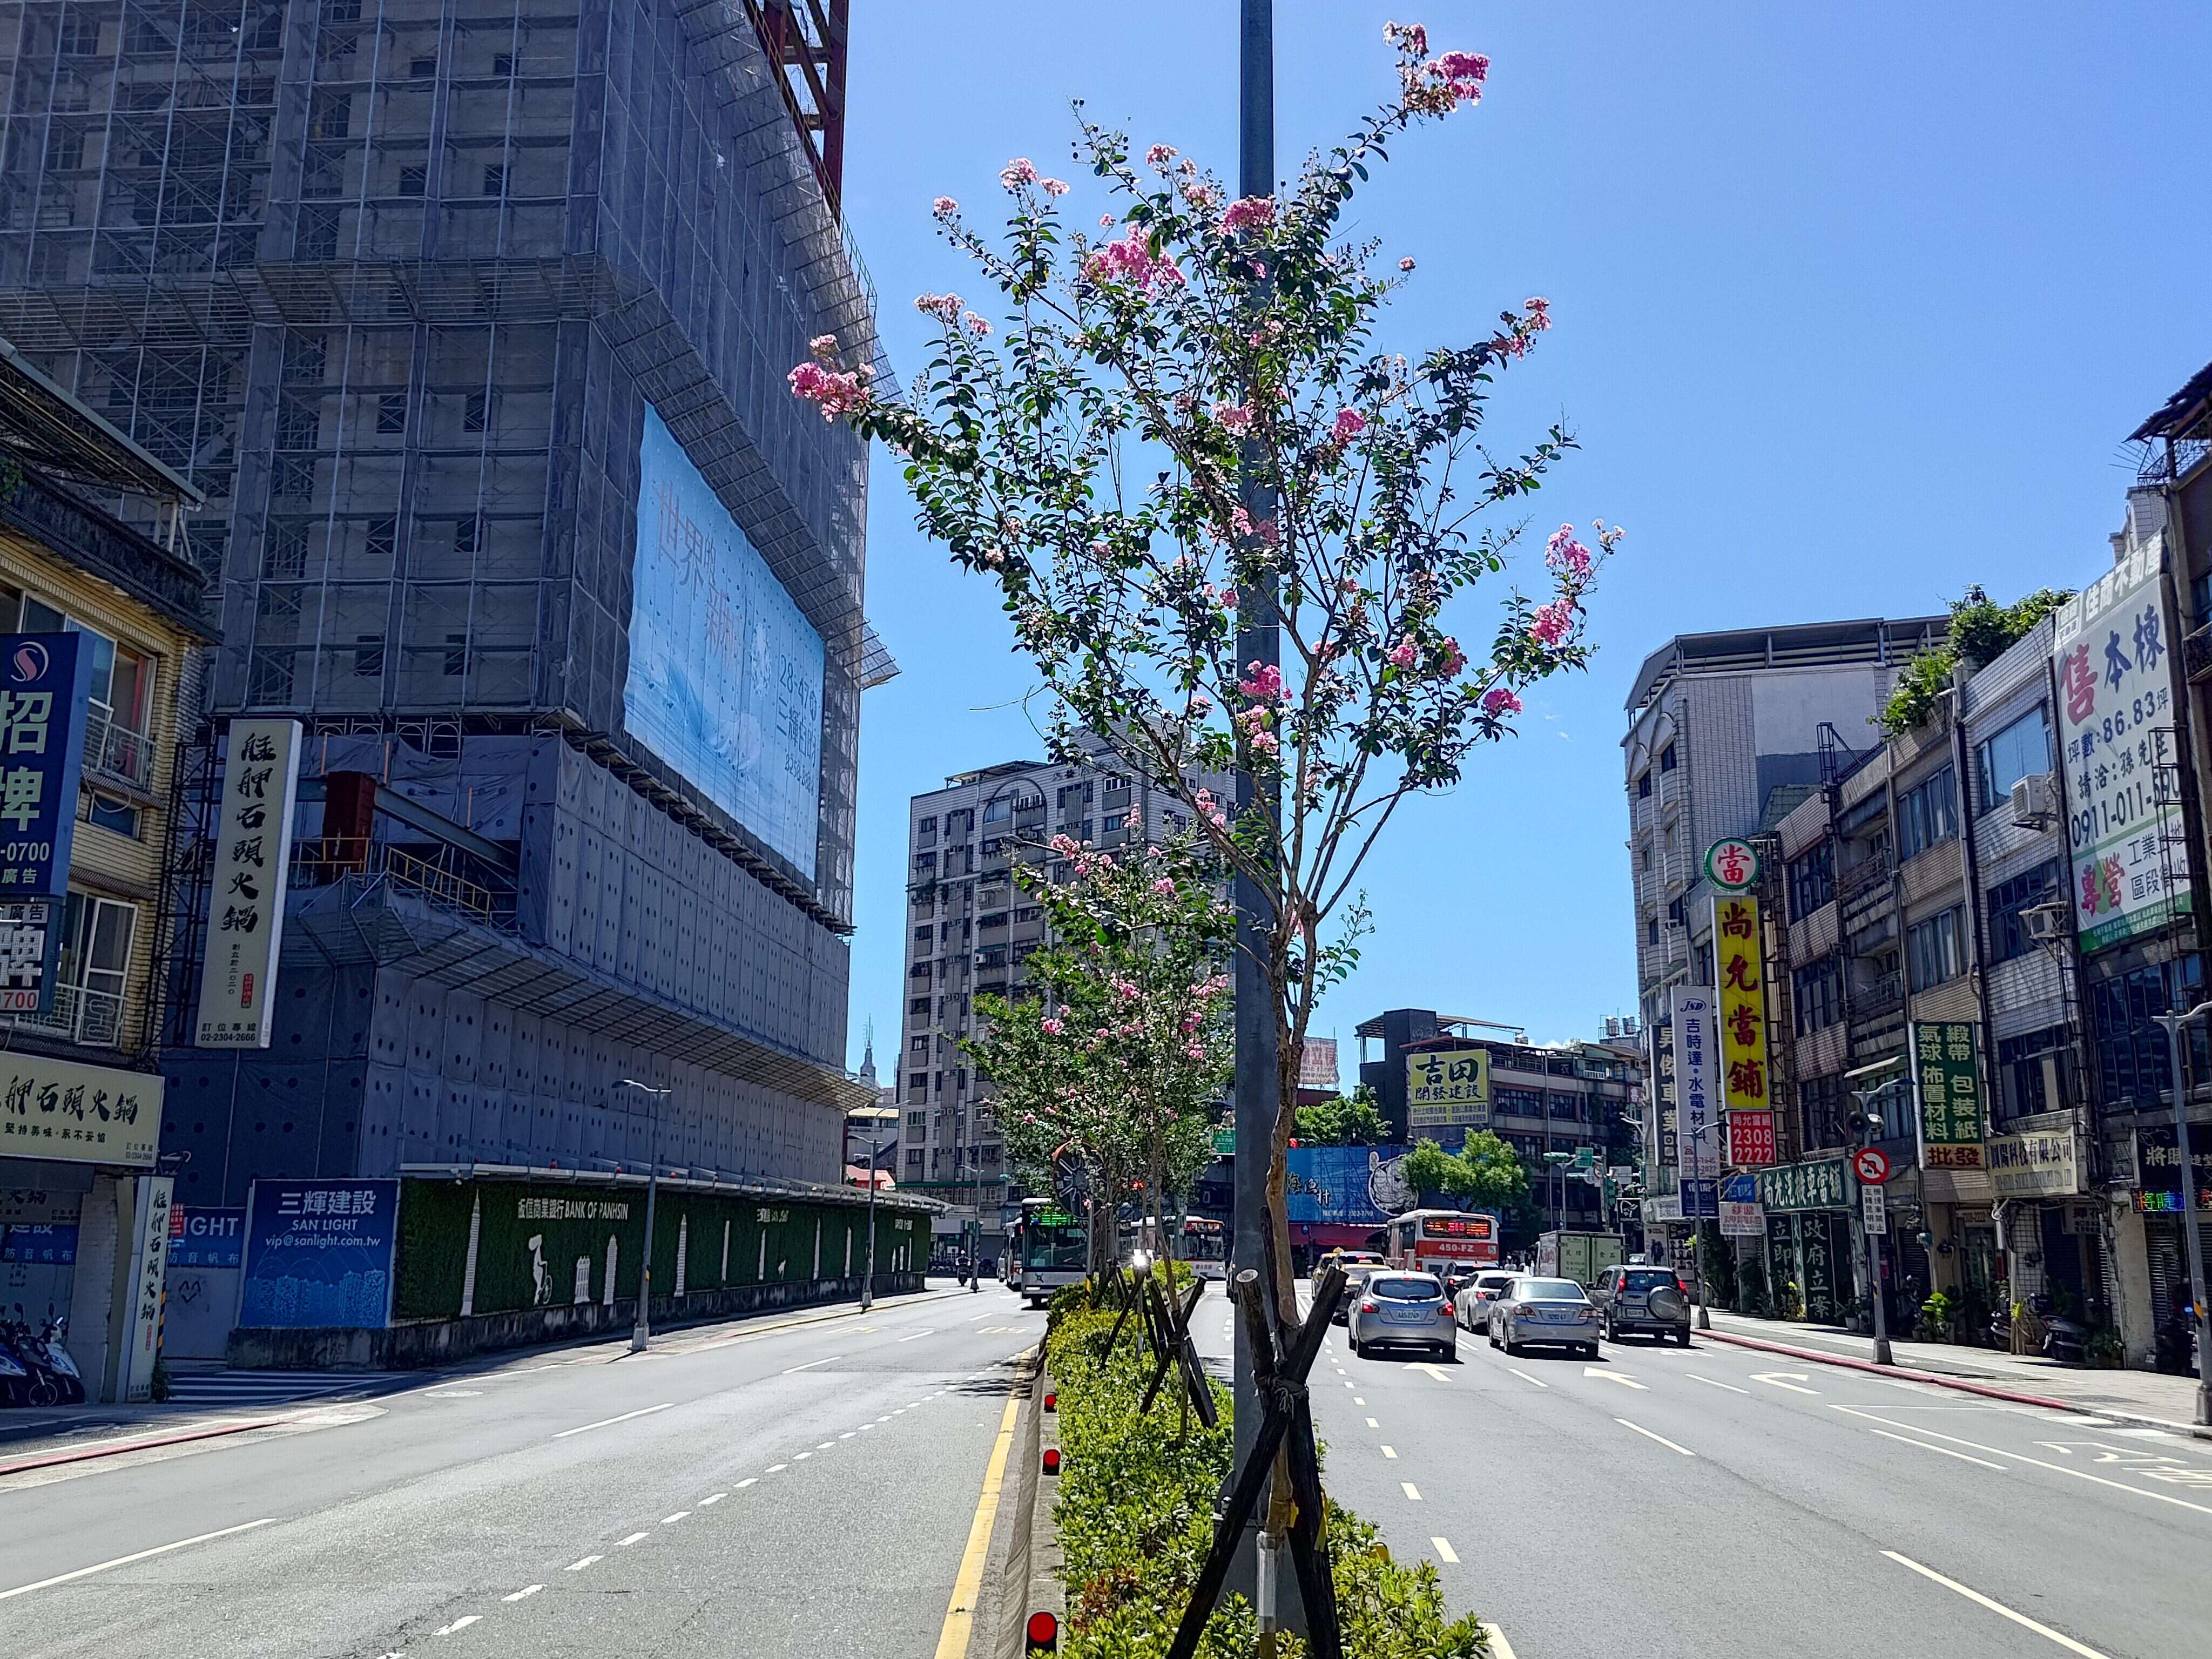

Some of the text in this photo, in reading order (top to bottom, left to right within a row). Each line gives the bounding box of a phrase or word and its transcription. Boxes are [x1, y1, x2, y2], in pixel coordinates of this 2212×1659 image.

[2086, 535, 2161, 622] 住商不動產
[2061, 604, 2166, 726] 售 本棟
[221, 731, 276, 933] 艋舺石頭火鍋
[2128, 820, 2184, 866] 工業土地
[1717, 843, 1750, 884] 當
[2081, 852, 2126, 916] 專營
[0, 991, 37, 1009] 700
[1722, 902, 1764, 1099] 尚允當鋪
[200, 1031, 255, 1042] 02-2304-2666
[1416, 1054, 1479, 1085] 吉田
[1918, 1024, 1949, 1141] 氣球 佈置材料
[1946, 1025, 1979, 1139] 緞帶 包裝紙
[0, 1074, 138, 1125] 舺石頭火鍋
[1415, 1084, 1482, 1101] 開發建設
[1734, 1130, 1772, 1145] 2308
[1735, 1147, 1773, 1162] 2222
[1927, 1147, 1981, 1166] 批發
[278, 1190, 376, 1216] 三輝建設
[518, 1197, 629, 1220] 板信商業銀行 BANK OF PANHSIN
[292, 1219, 358, 1231] SAN LIGHT
[265, 1233, 381, 1250] vip@sanlight.com.tw
[1439, 1243, 1474, 1252] 450-FZ
[1804, 1218, 1832, 1318] 政府立案
